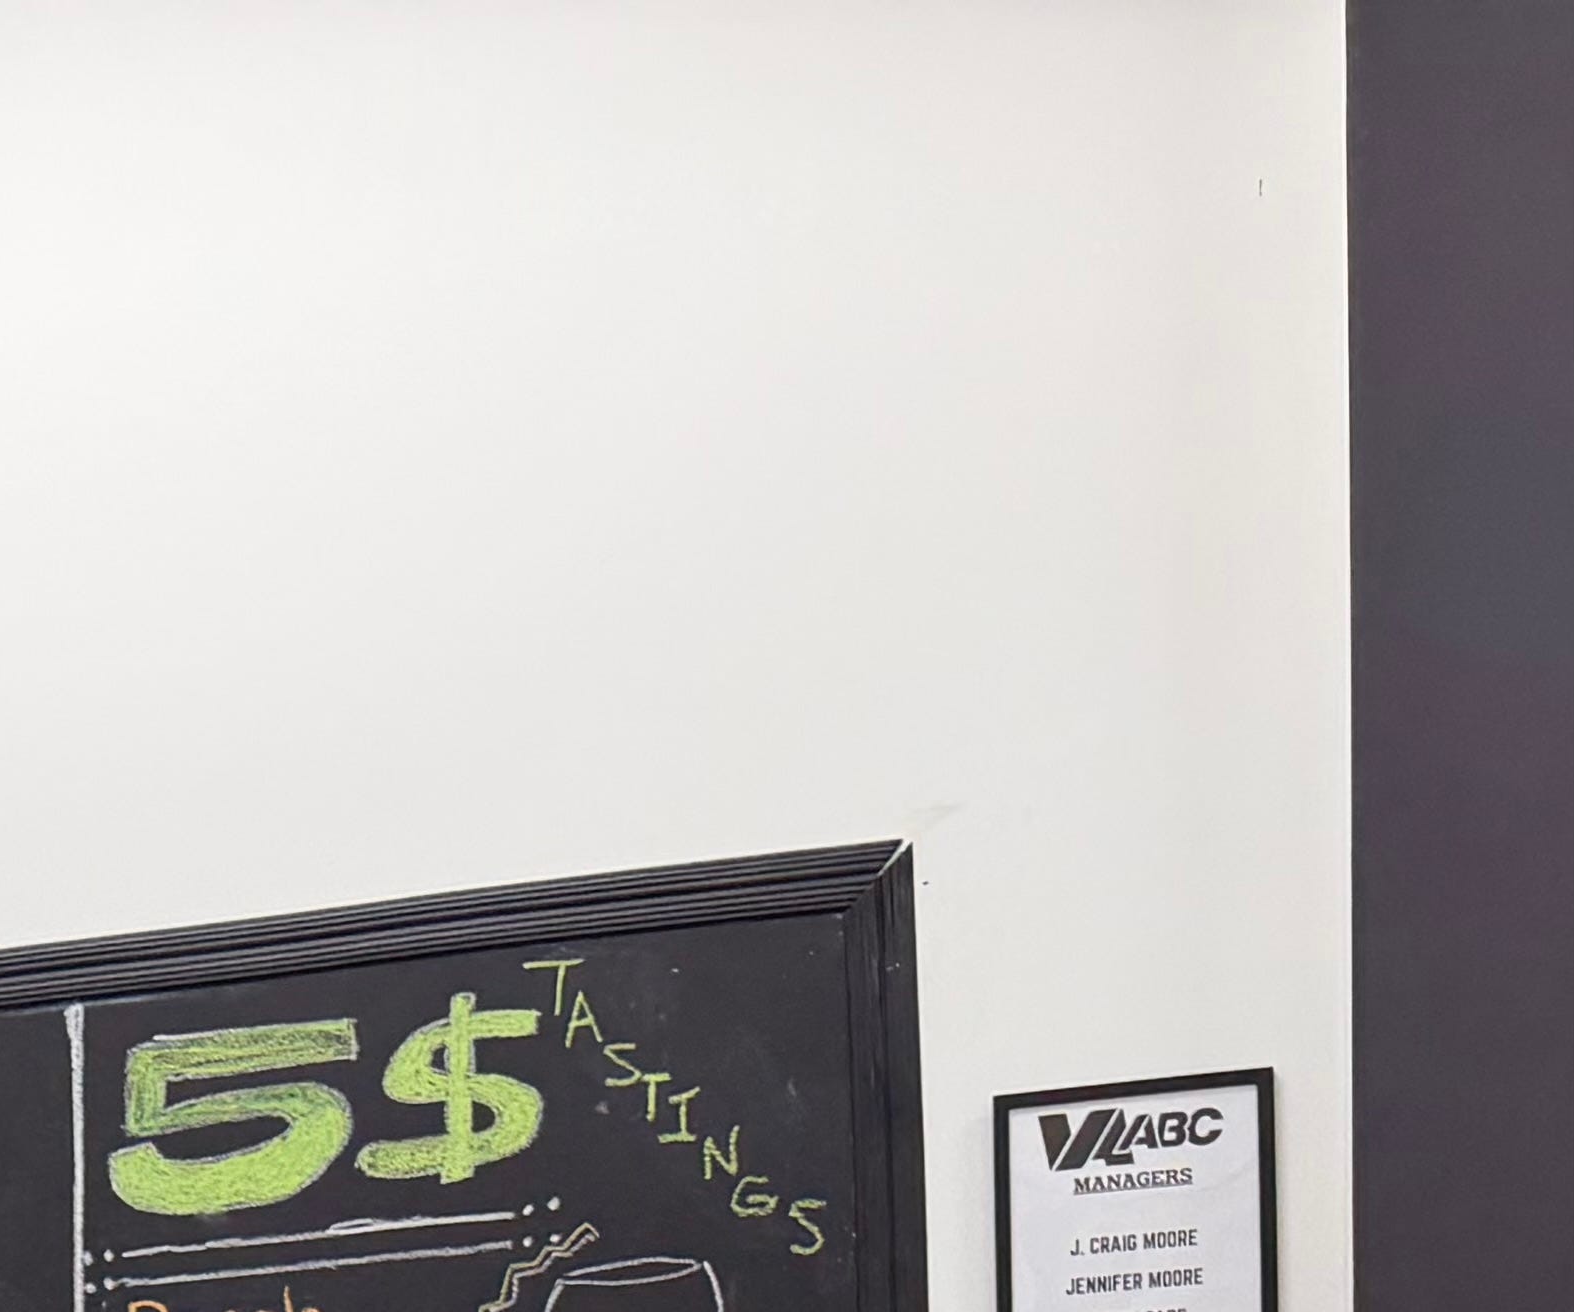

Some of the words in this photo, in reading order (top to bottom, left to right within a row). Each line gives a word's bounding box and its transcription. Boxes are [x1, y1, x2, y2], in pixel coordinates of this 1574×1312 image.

[1073, 1167, 1194, 1195] MANAGERS
[1070, 1239, 1085, 1257] J.
[1089, 1234, 1138, 1254] CRAIG
[1142, 1228, 1199, 1250] MOORE
[1065, 1272, 1143, 1296] JENNIFER
[1148, 1267, 1204, 1289] MOORE
